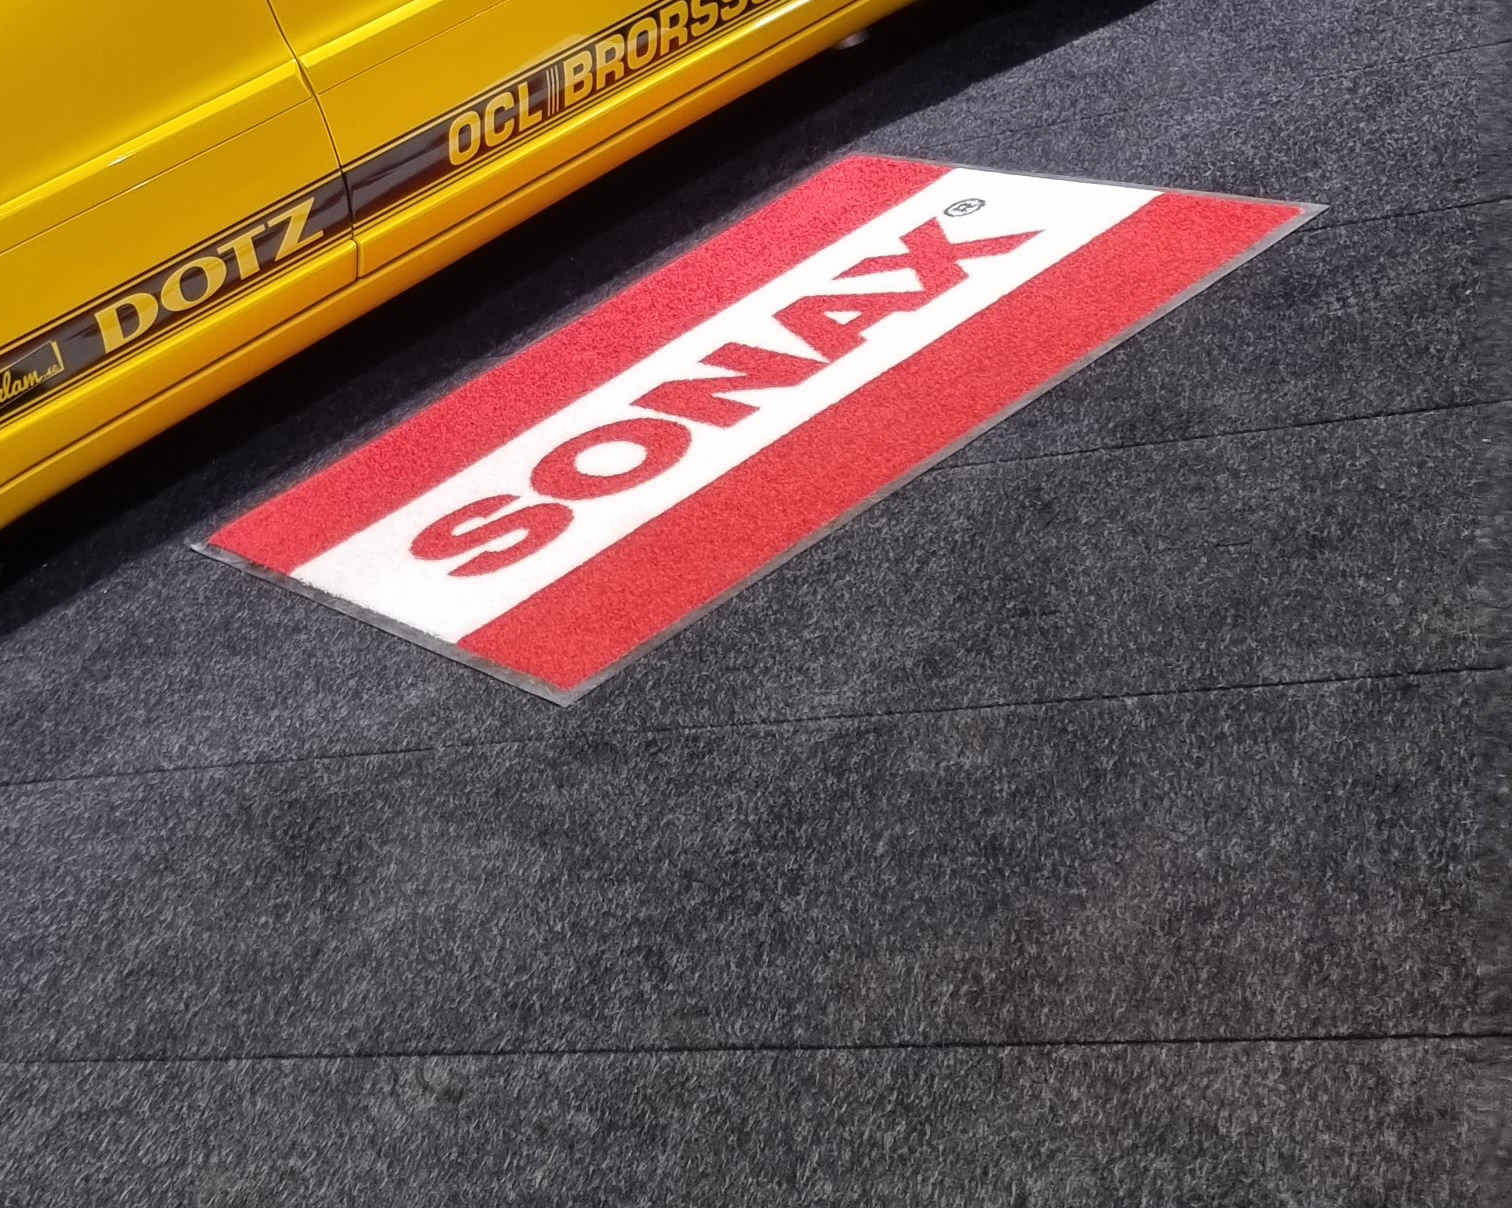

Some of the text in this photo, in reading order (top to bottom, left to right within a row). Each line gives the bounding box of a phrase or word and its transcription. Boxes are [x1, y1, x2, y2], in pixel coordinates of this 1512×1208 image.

[447, 79, 544, 166] OCL
[95, 196, 325, 354] DOTZ
[412, 216, 1047, 578] SONAX
